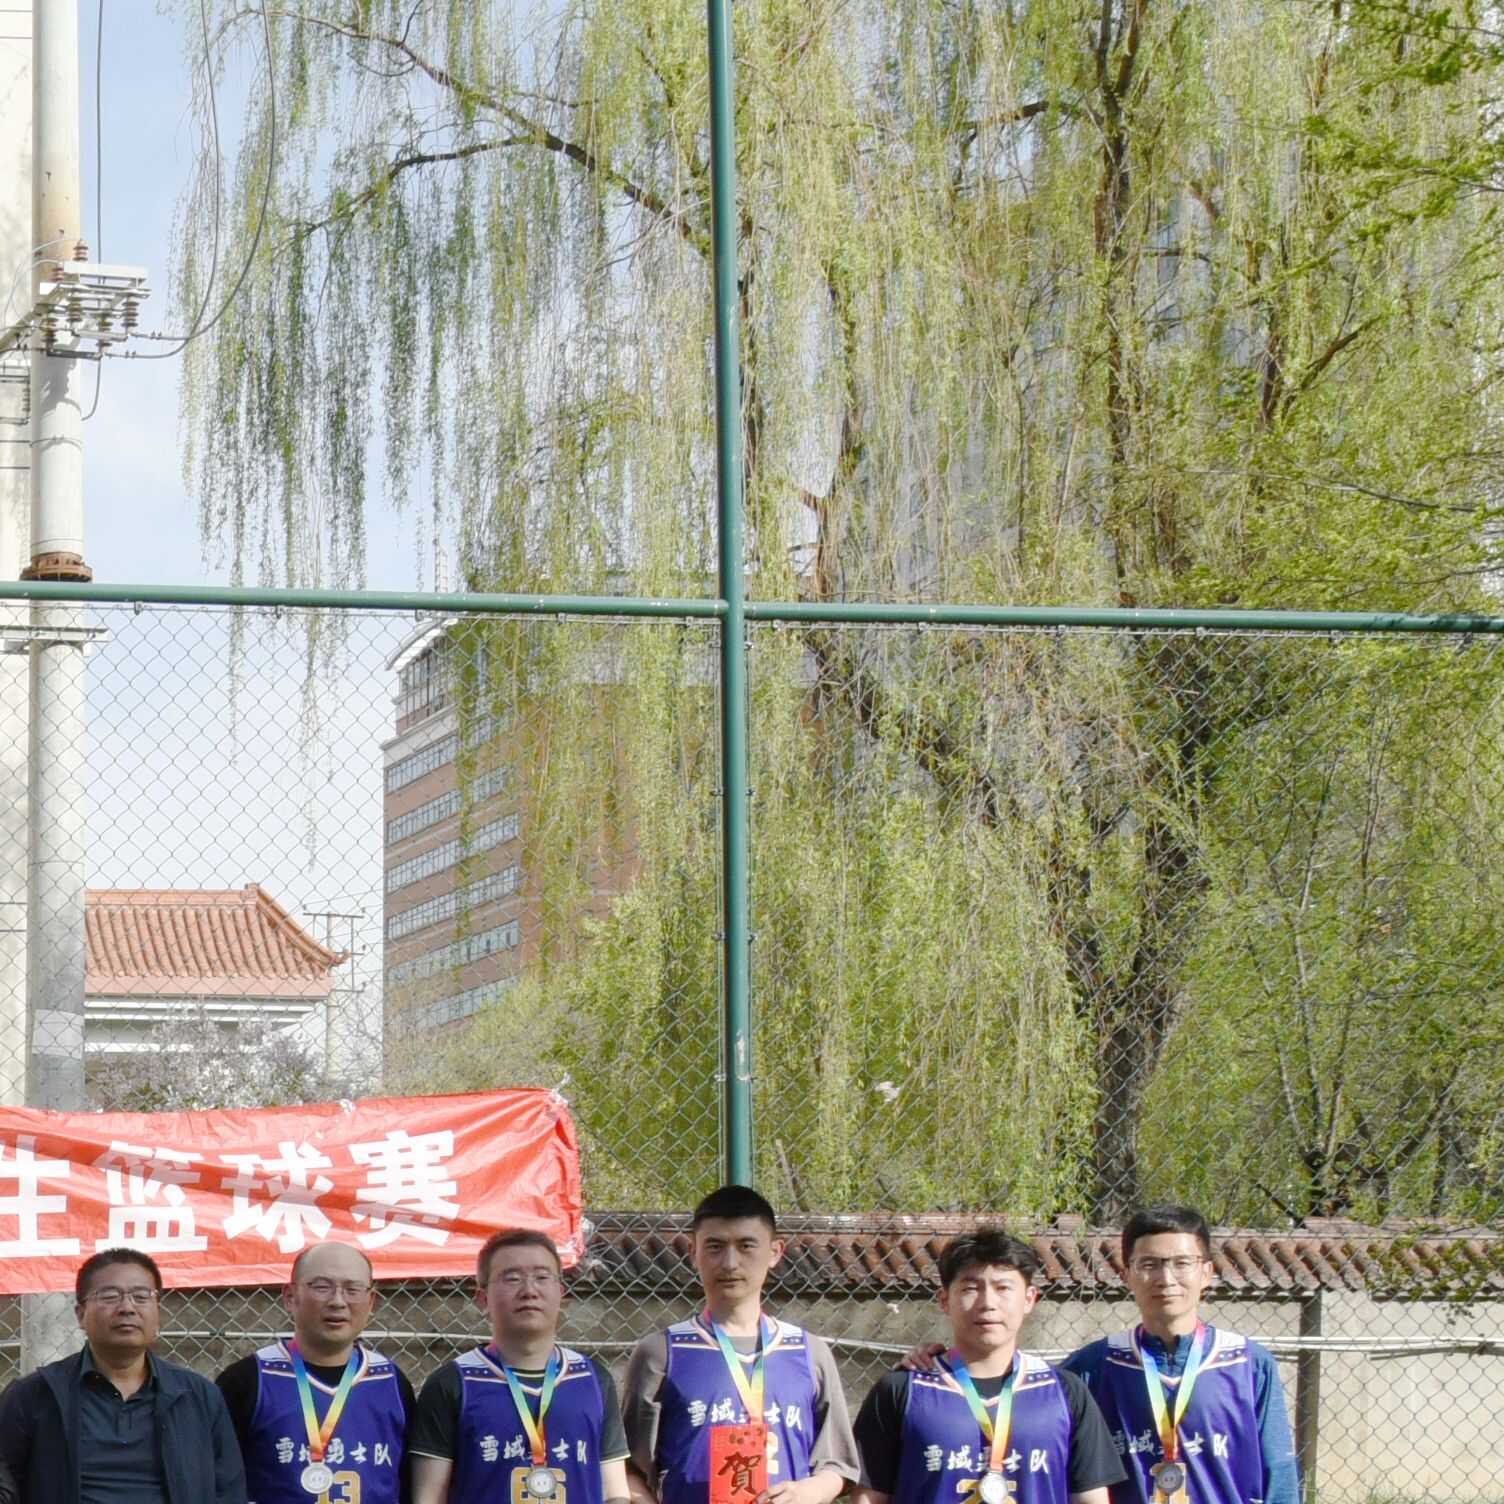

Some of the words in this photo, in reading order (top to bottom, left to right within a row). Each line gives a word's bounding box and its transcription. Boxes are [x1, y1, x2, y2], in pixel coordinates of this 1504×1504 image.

[687, 1398, 802, 1432] 雪域士队
[479, 1433, 588, 1464] 雪域士队
[1112, 1429, 1229, 1459] 雪域士队
